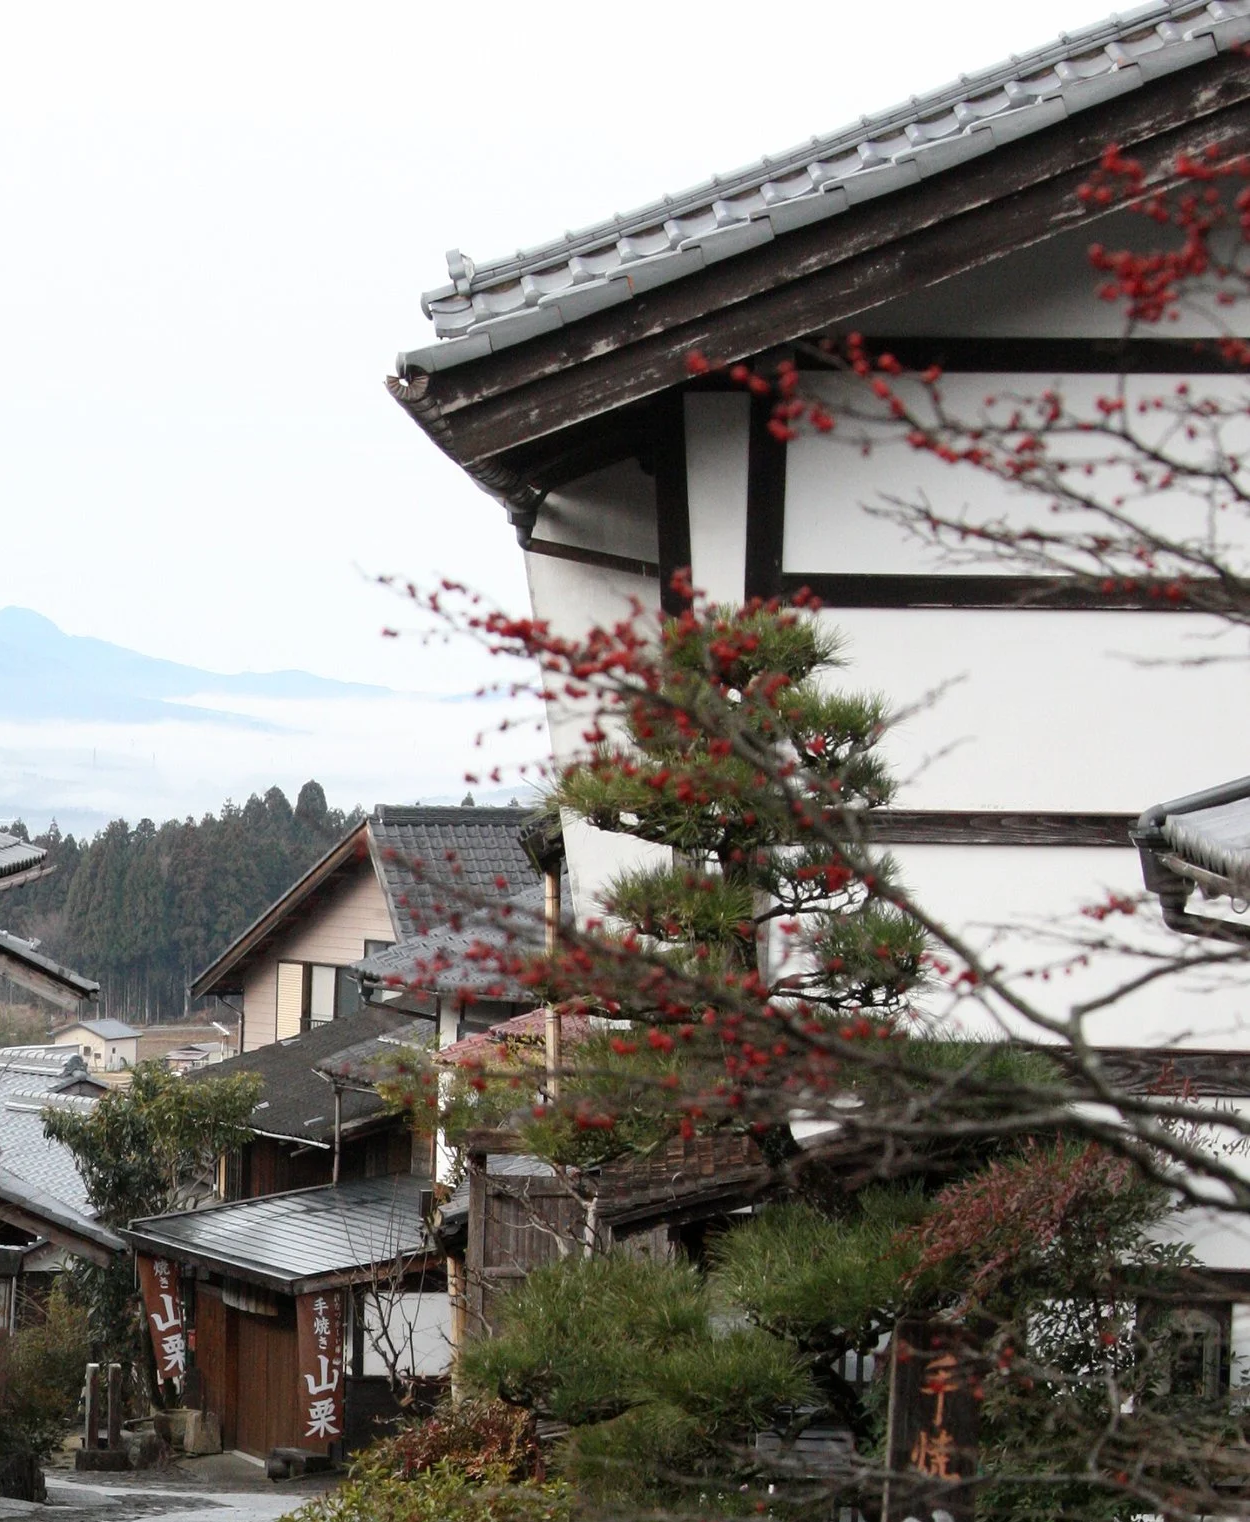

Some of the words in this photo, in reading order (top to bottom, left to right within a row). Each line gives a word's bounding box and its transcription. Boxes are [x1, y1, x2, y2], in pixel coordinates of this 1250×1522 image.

[304, 1297, 342, 1439] 手焼き山栗
